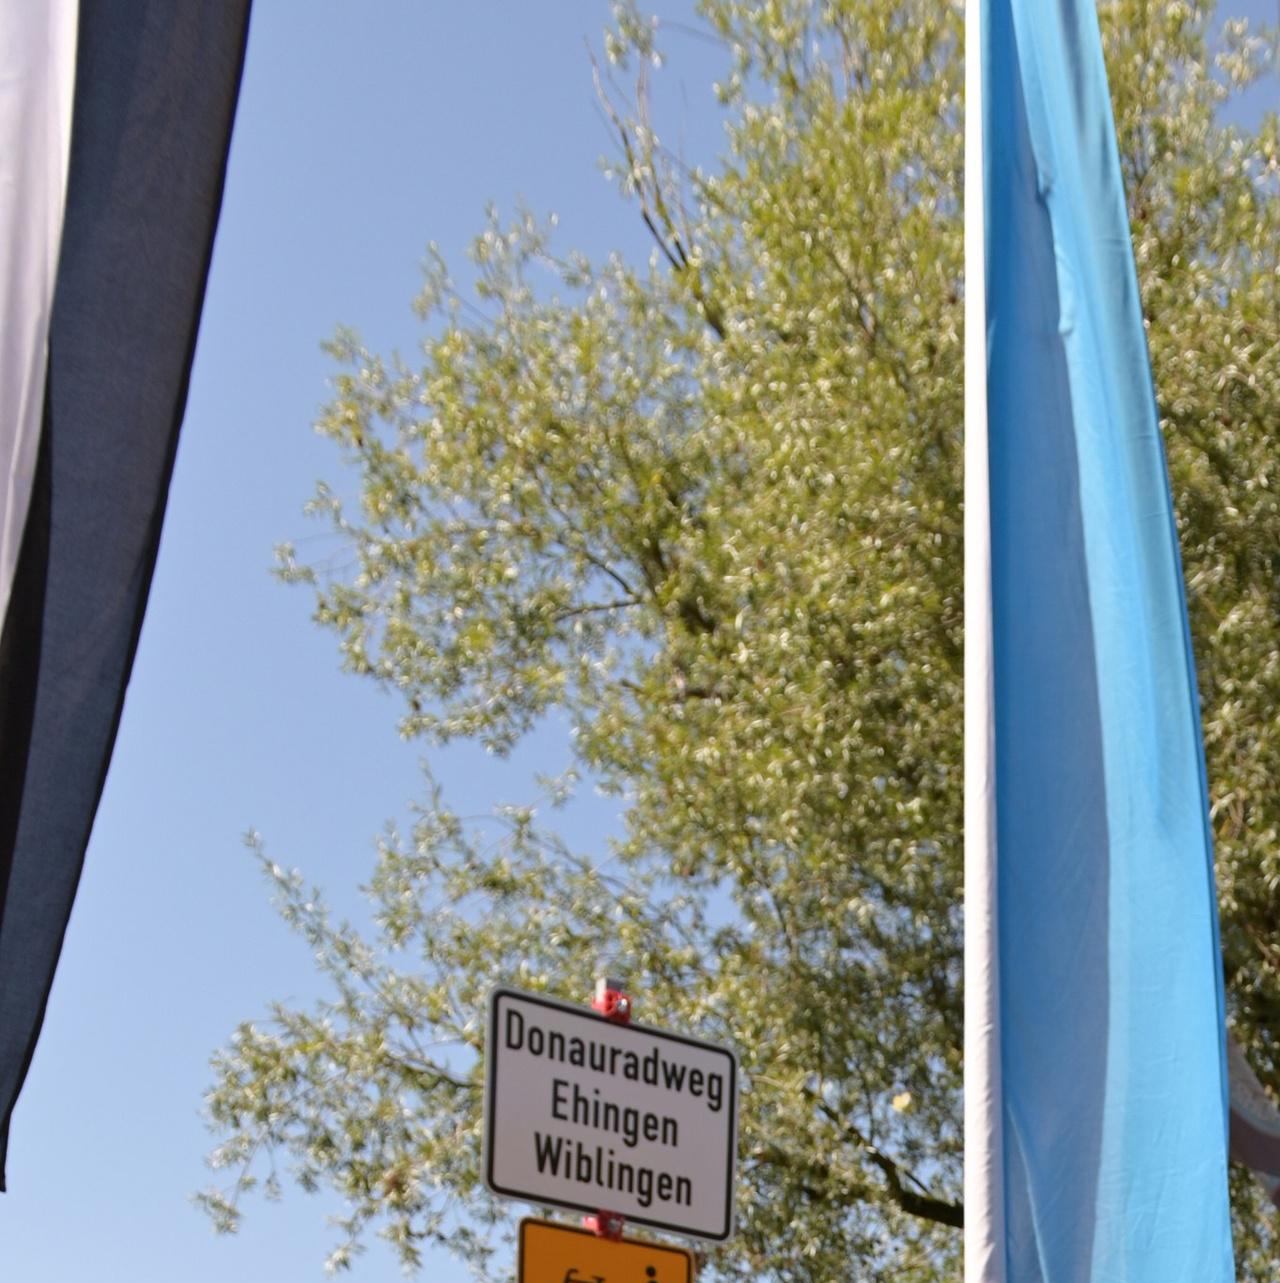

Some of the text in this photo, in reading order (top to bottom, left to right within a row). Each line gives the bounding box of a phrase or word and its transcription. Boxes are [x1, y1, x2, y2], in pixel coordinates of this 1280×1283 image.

[505, 1008, 722, 1112] Donauradweg
[552, 1078, 678, 1147] Ehingen
[534, 1131, 691, 1207] Wiblingen
